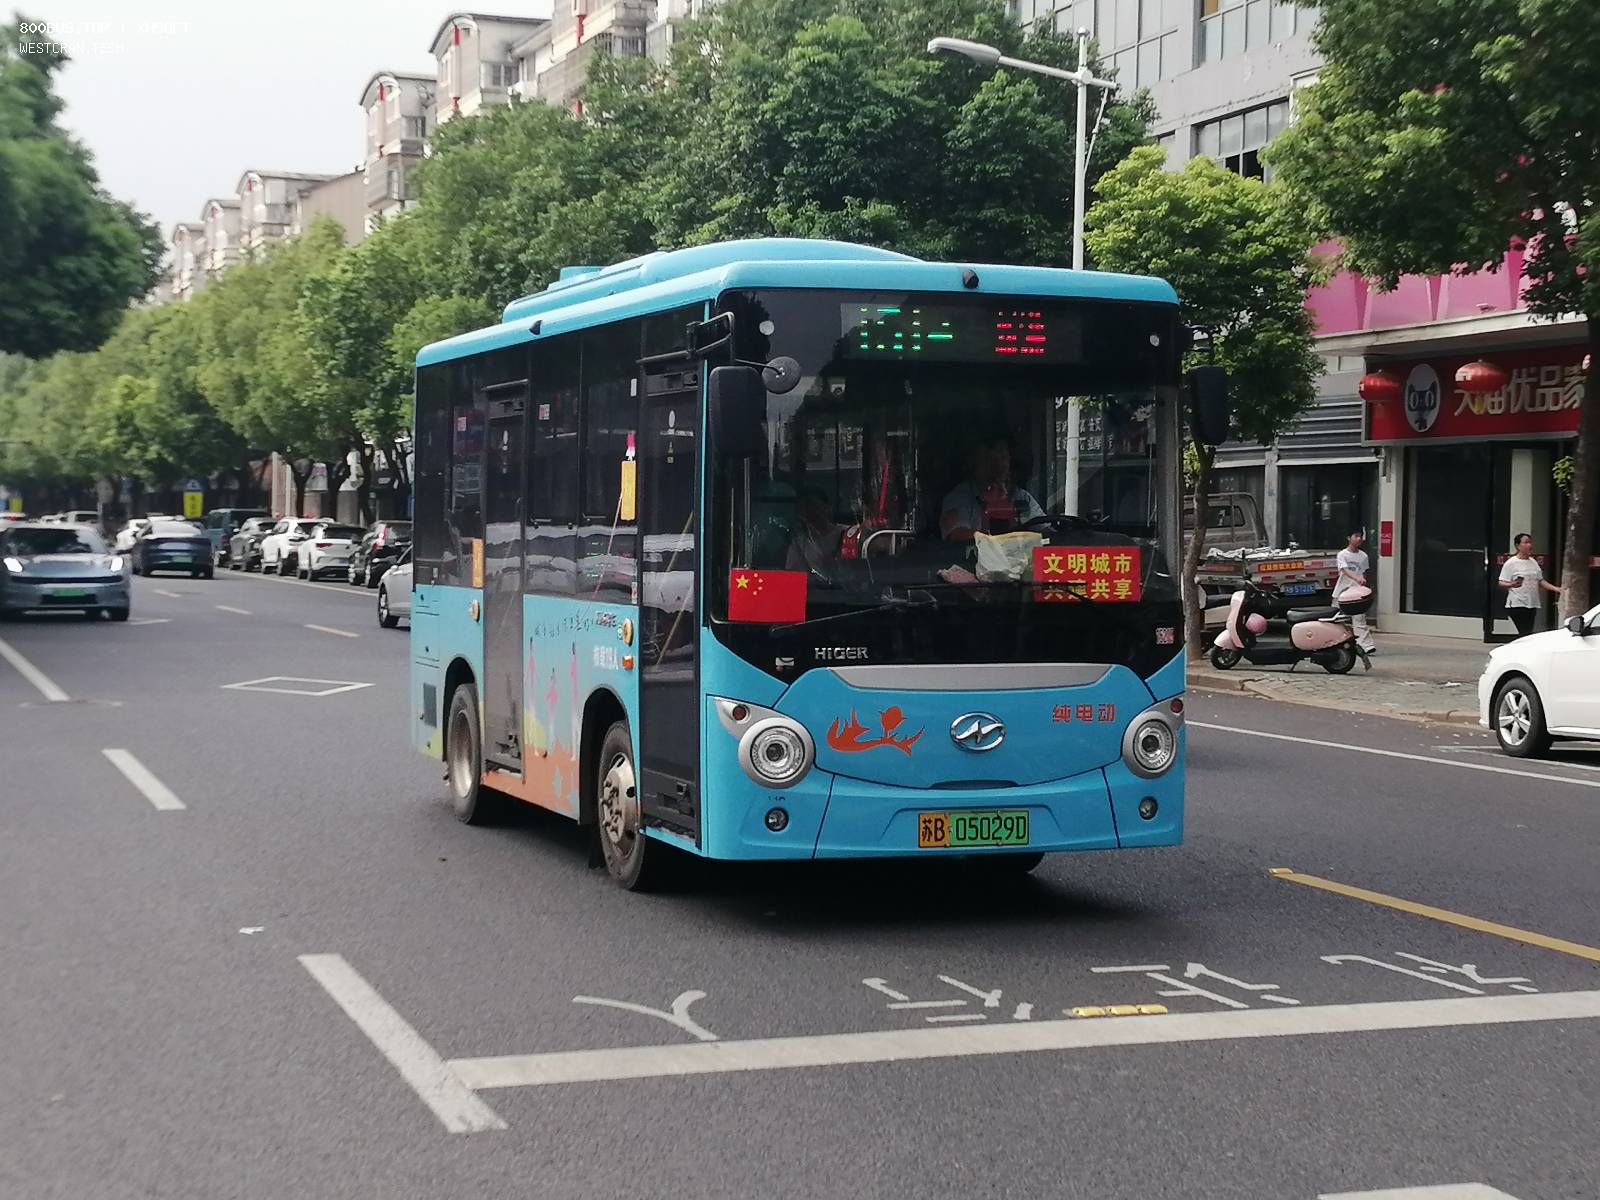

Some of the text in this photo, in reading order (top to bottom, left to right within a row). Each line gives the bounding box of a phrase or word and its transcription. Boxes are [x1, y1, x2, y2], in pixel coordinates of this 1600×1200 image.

[1043, 553, 1132, 575] 文明城市
[814, 646, 869, 660] HIGER
[1052, 704, 1116, 722] 纯电动
